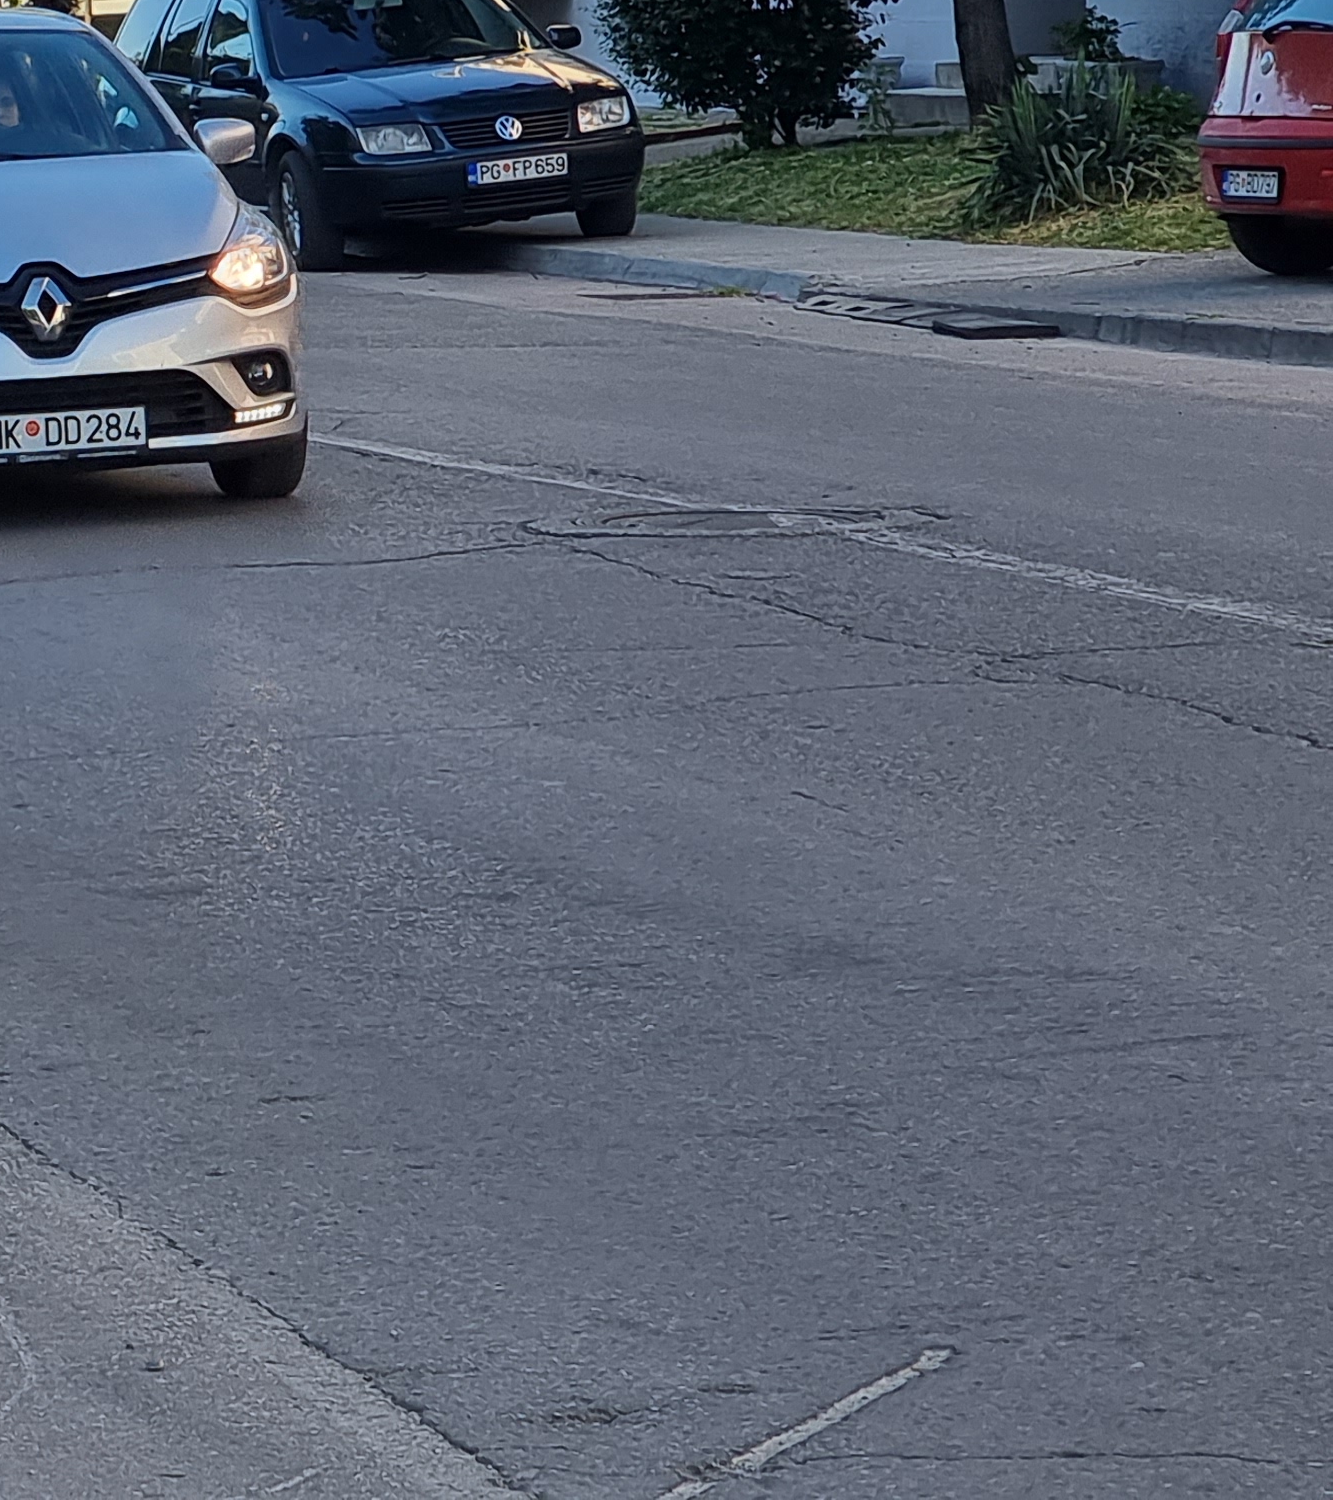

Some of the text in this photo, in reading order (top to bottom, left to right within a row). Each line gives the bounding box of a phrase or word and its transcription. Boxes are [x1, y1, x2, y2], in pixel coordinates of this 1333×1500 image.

[479, 156, 566, 181] PG FP659
[44, 411, 141, 446] DD284
